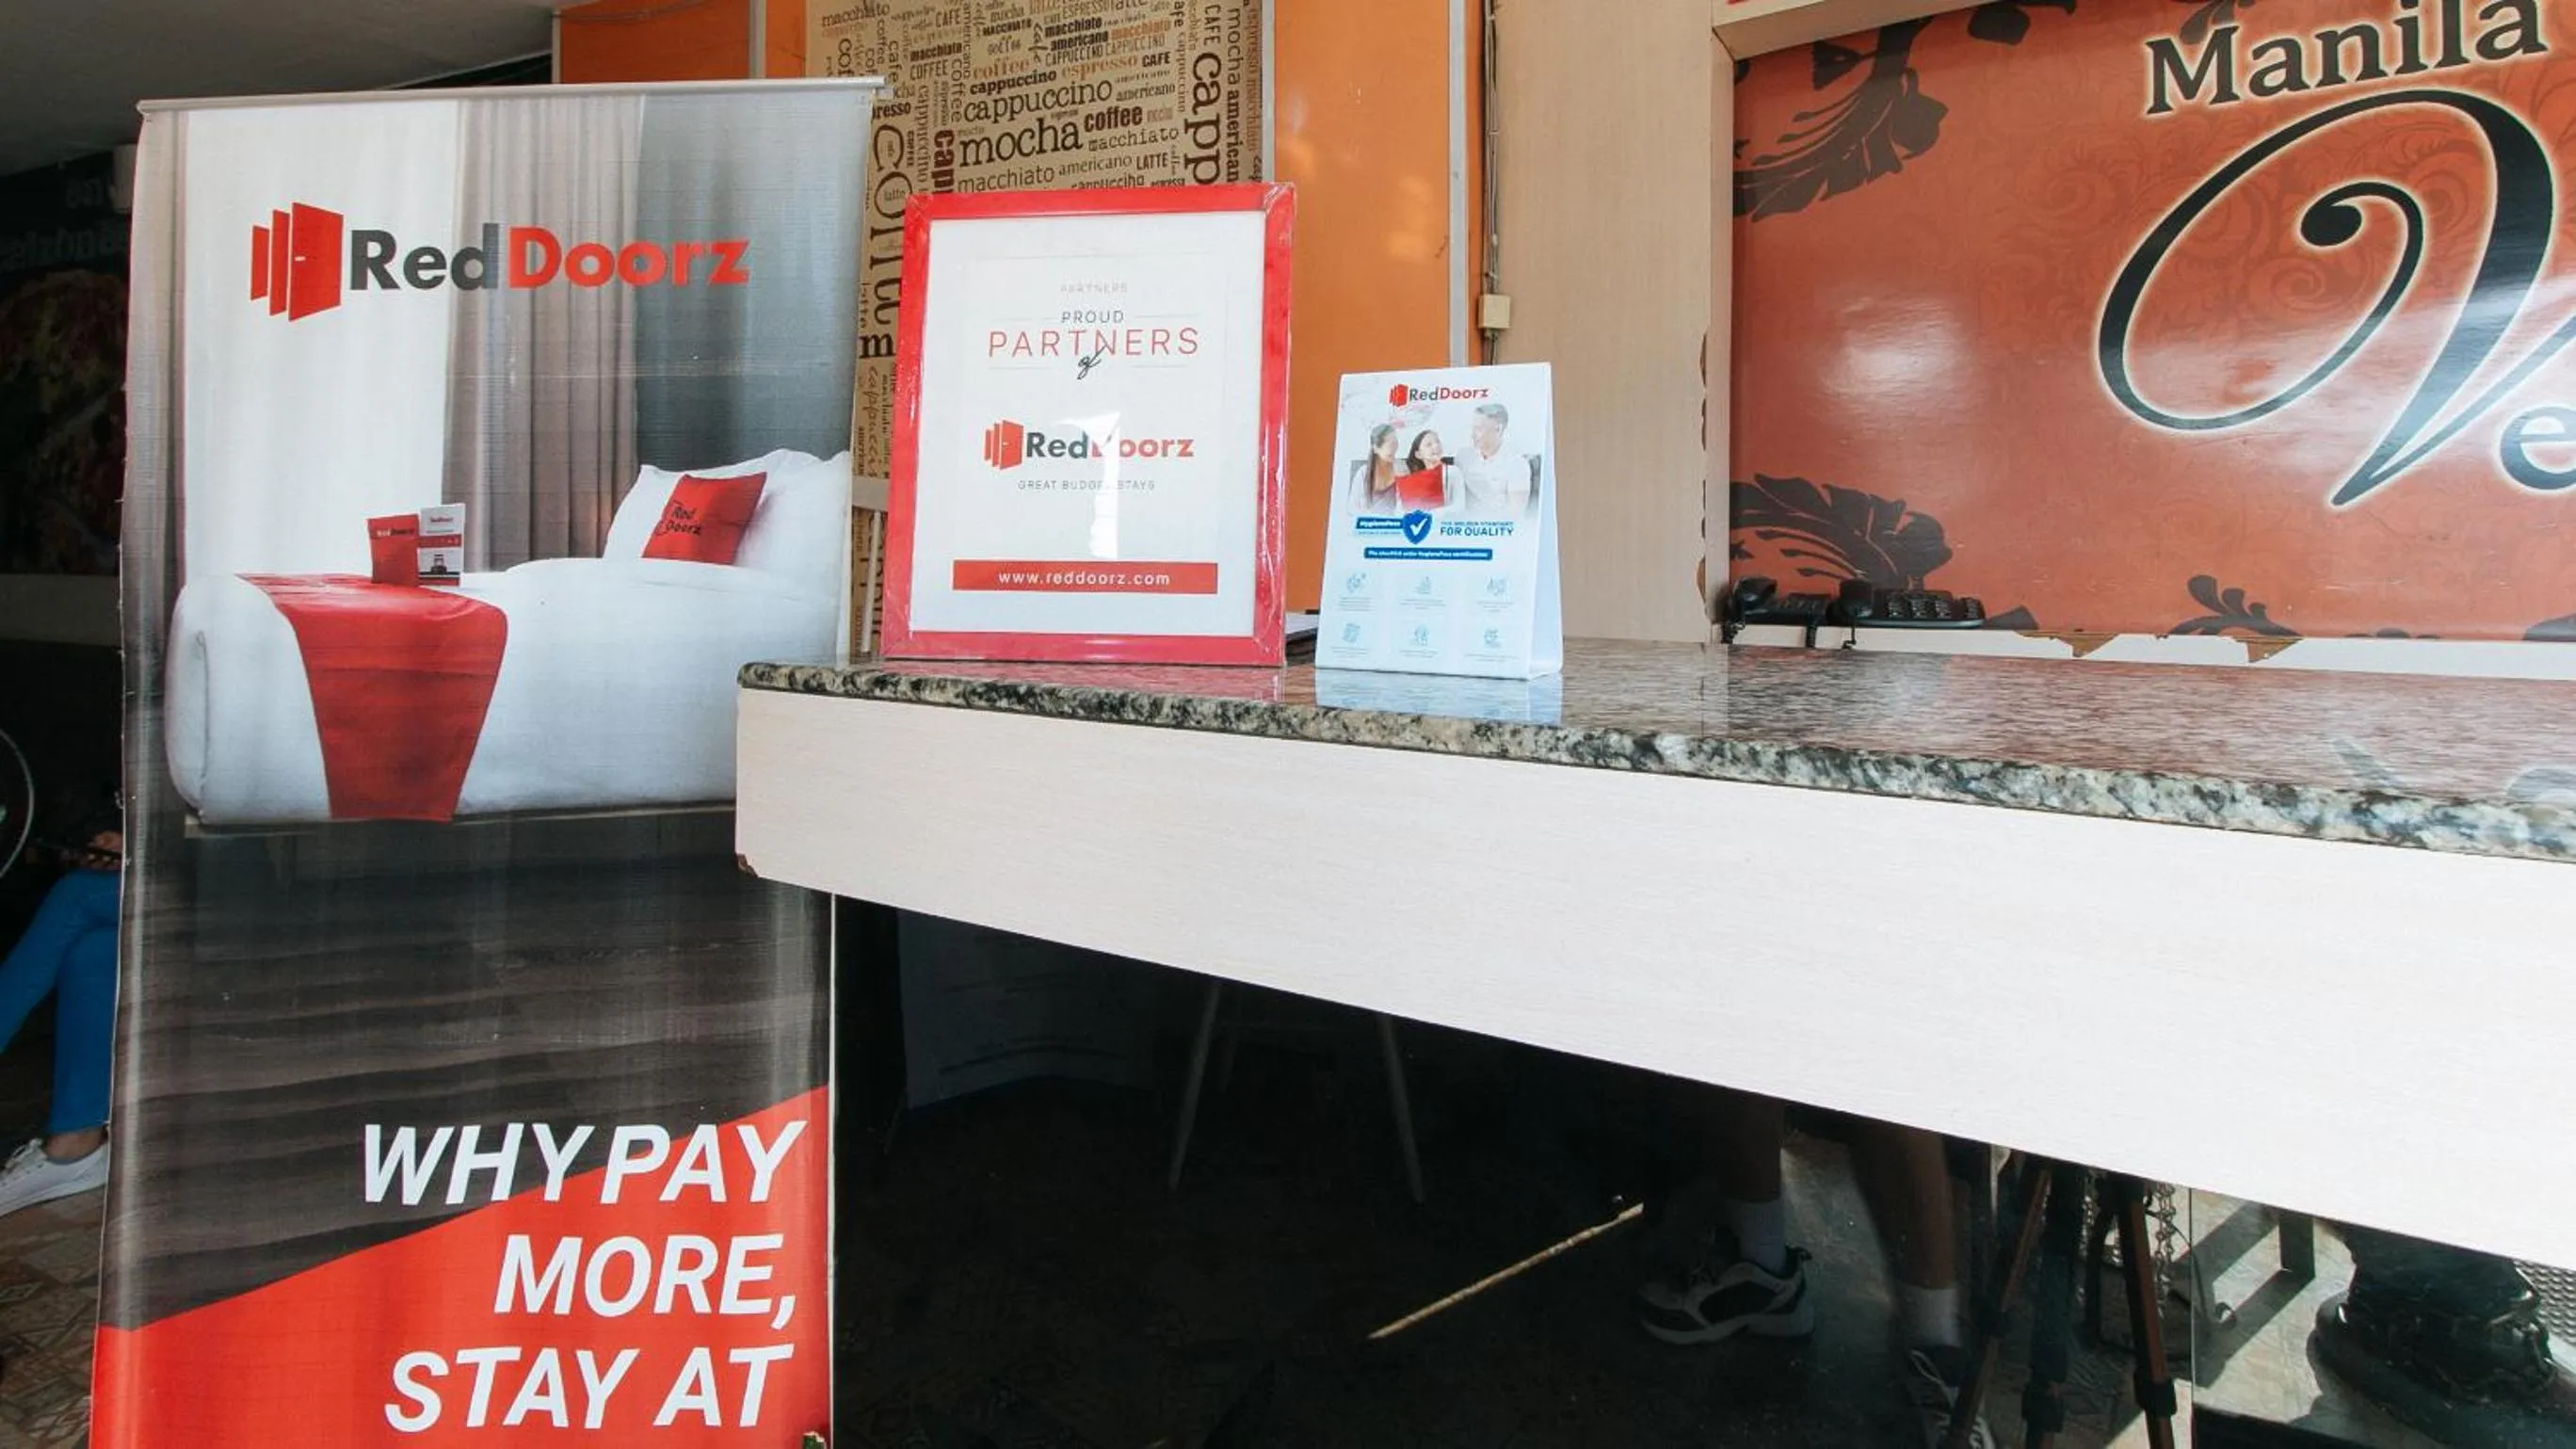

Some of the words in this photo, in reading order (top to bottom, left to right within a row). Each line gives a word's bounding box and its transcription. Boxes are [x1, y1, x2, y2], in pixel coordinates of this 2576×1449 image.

[936, 8, 962, 28] CAFE
[1044, 17, 1103, 38] macchiato
[1203, 4, 1221, 46] CAFE
[910, 42, 962, 62] macchiato
[1050, 30, 1109, 51] americano
[1226, 8, 1243, 85] mocha
[889, 40, 902, 83] cafe
[910, 59, 948, 82] COFFEE
[973, 56, 1030, 79] coffee
[1062, 54, 1139, 81] espresso
[1142, 51, 1171, 68] CAFE
[2146, 0, 2550, 115] Manila
[951, 58, 966, 122] coffee
[970, 68, 1057, 95] cappuccino
[963, 79, 1113, 124] cappuccino
[1084, 105, 1143, 133] coffee
[914, 85, 930, 183] cappuccino
[959, 117, 1083, 168] mocha
[1088, 128, 1180, 153] macchiato
[1059, 154, 1133, 176] americano
[1136, 153, 1167, 170] LATTE
[958, 164, 1055, 193] macchiato
[349, 222, 750, 293] RedDoorz
[1061, 310, 1125, 324] PROUD
[989, 328, 1199, 358] PARTNERS
[1409, 386, 1489, 403] RedDoorz
[1018, 480, 1057, 491] GREAT
[1062, 479, 1104, 491] BUDGE
[1441, 526, 1462, 536] FOR
[1464, 526, 1514, 537] QUALITY
[998, 570, 1170, 587] www.reddoorz.com
[364, 1122, 595, 1206] WHY
[601, 1120, 808, 1205] PAY
[493, 1232, 797, 1330] MORE,
[385, 1346, 640, 1433] STAY
[652, 1343, 795, 1428] AT
